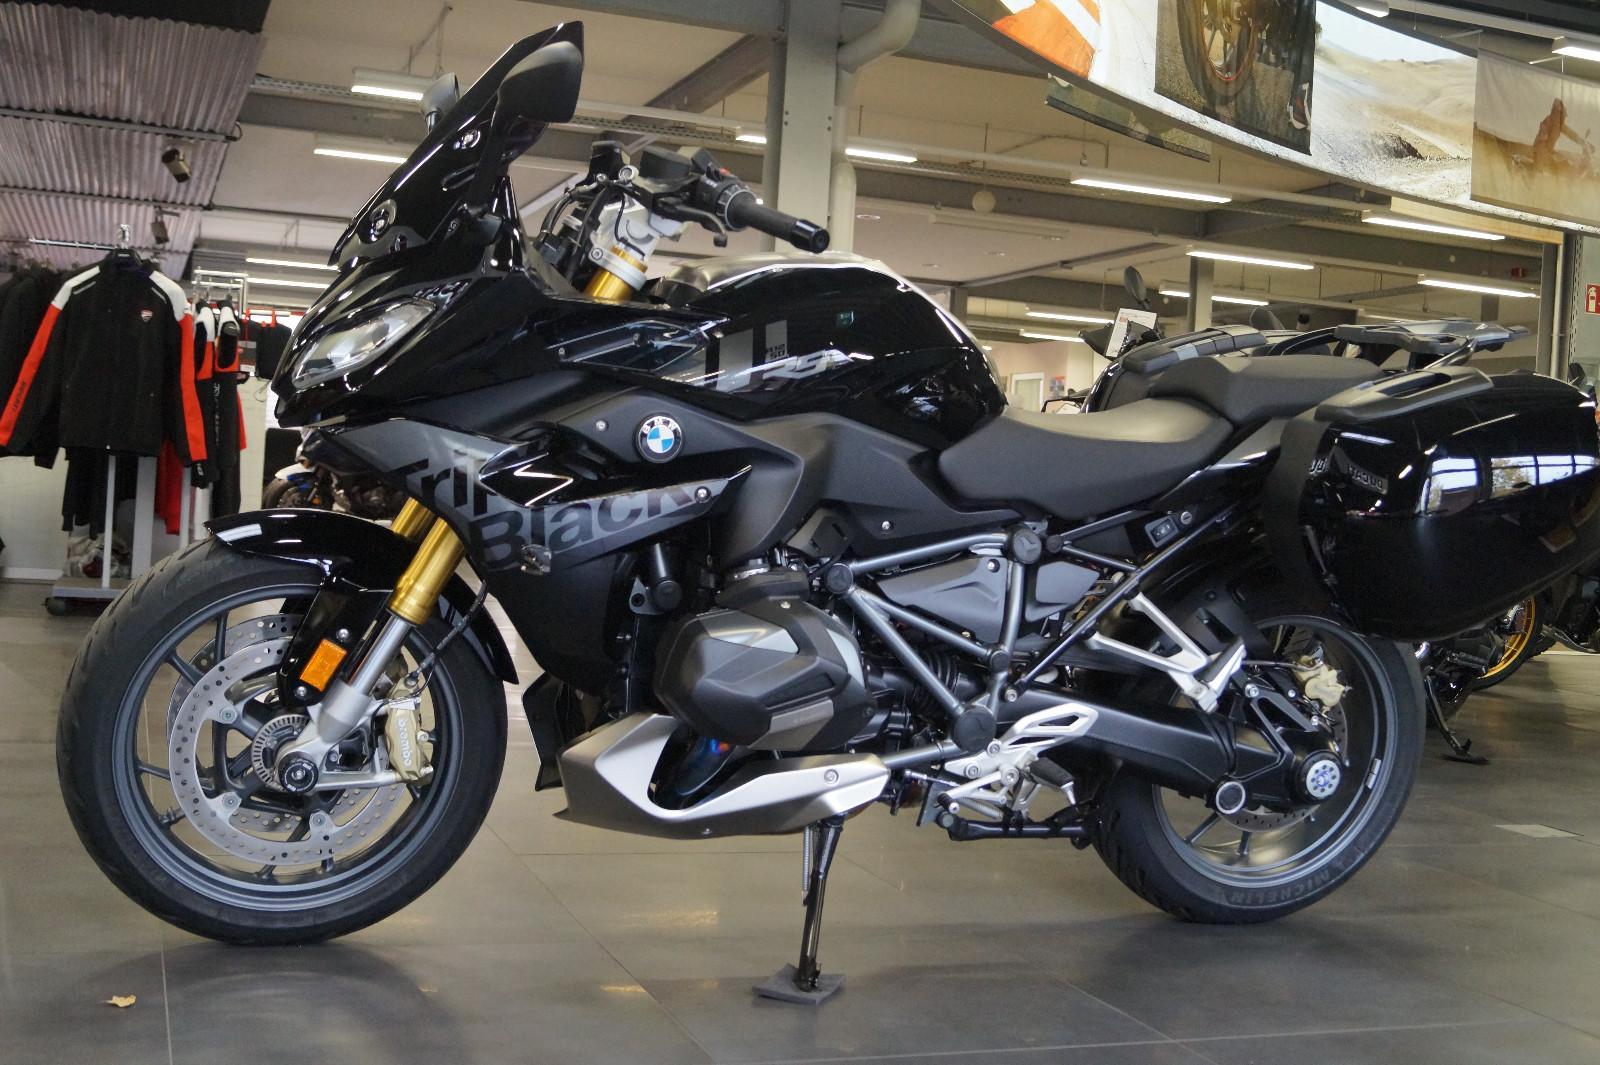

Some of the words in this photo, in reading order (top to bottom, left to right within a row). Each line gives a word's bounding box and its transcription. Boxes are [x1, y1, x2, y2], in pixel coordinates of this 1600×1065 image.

[640, 416, 681, 434] BMW
[397, 718, 412, 767] brembo
[1231, 869, 1330, 904] MICHELIN
